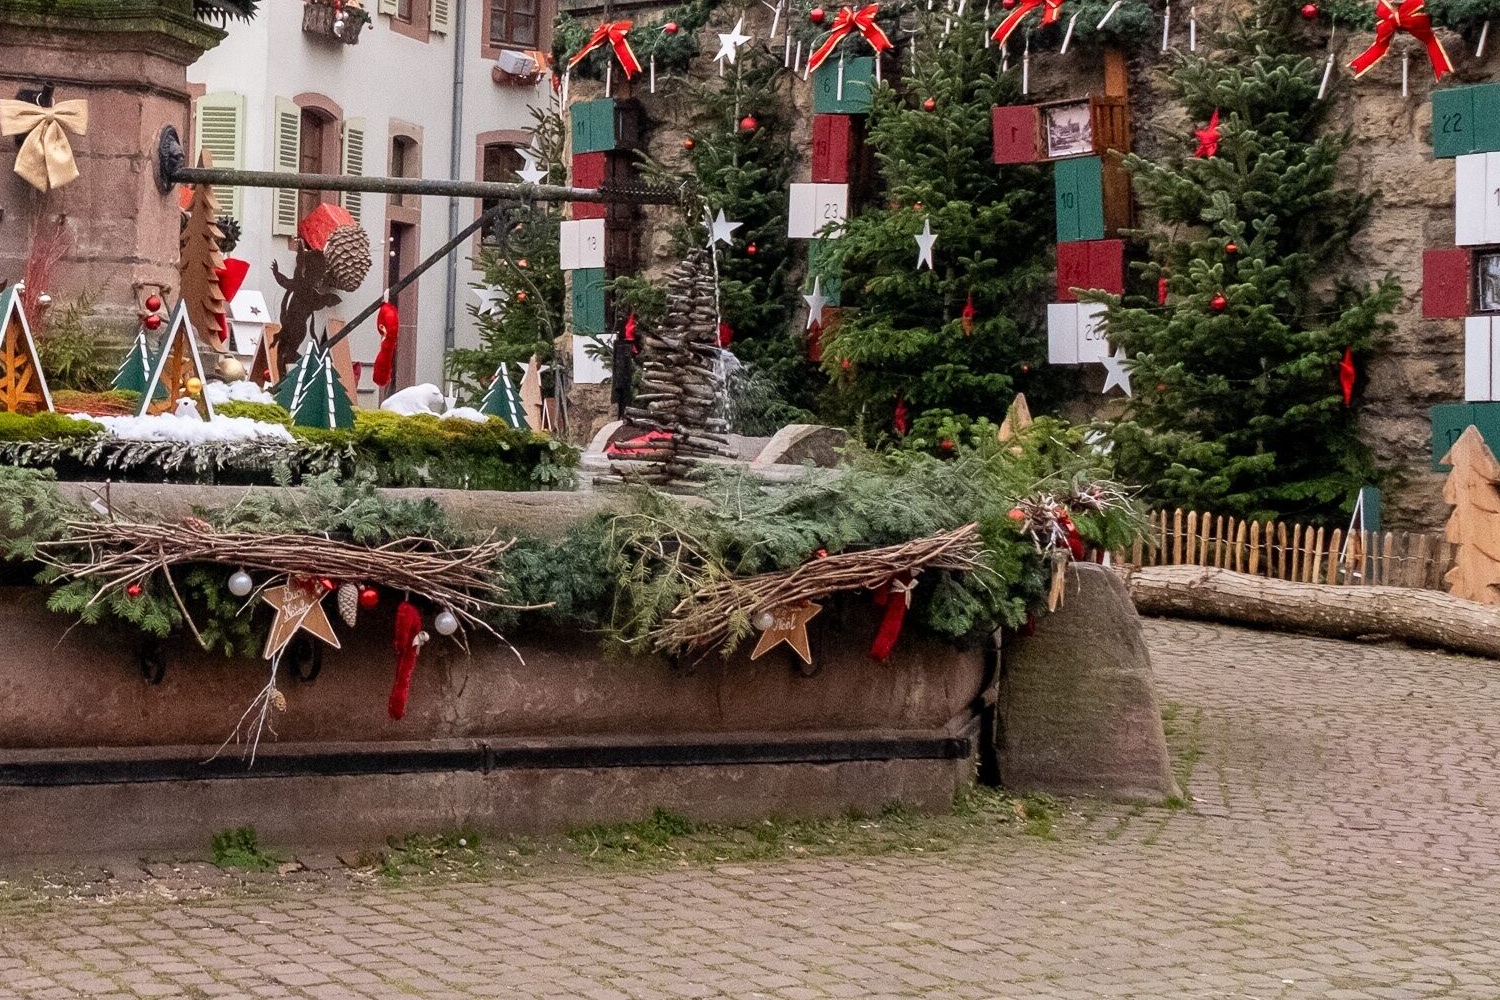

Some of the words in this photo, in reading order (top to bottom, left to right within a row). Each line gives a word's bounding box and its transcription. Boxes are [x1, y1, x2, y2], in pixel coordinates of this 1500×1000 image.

[1443, 112, 1462, 133] 22
[1061, 192, 1074, 209] 10
[824, 203, 839, 219] 23
